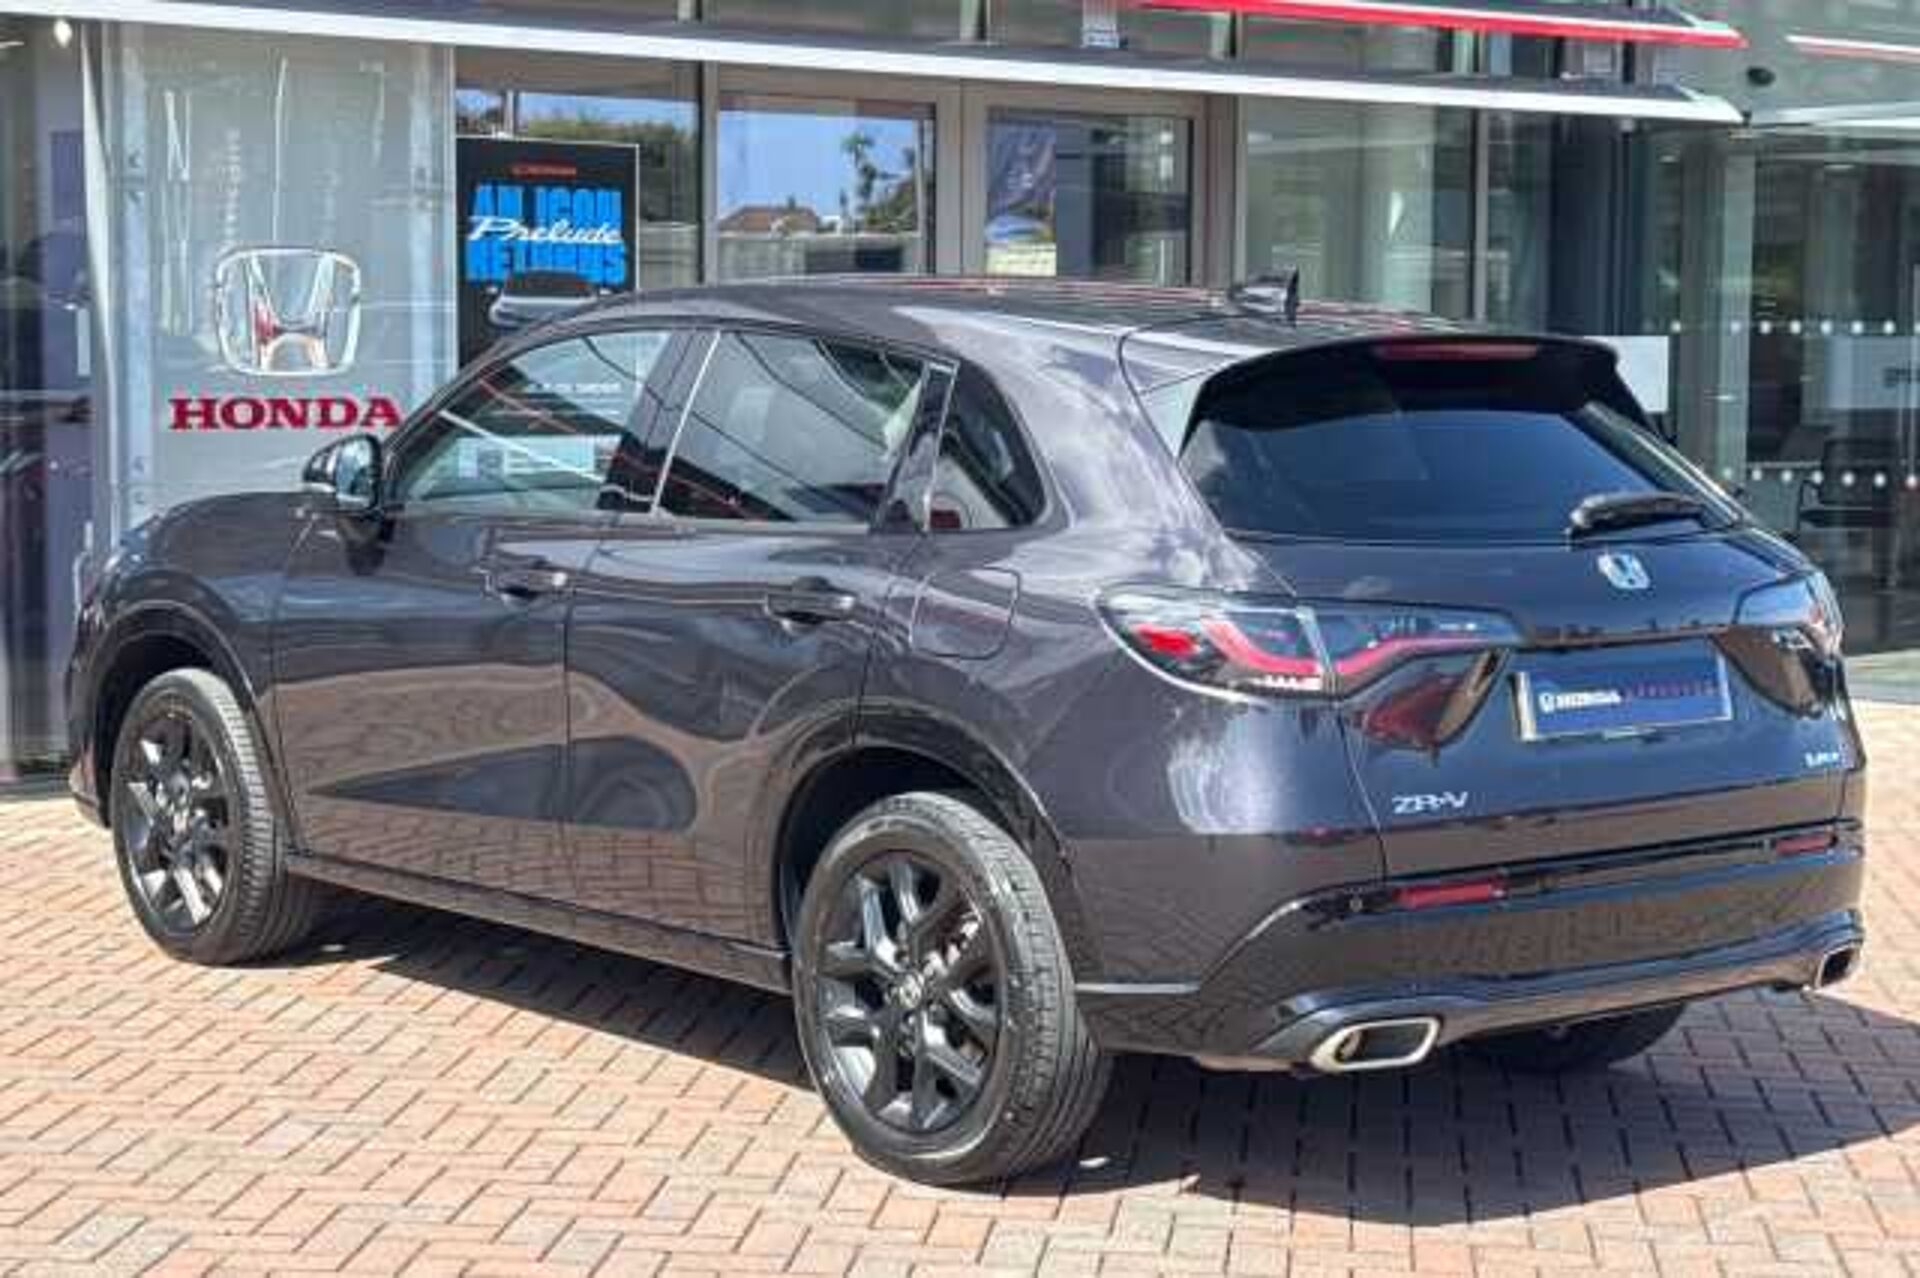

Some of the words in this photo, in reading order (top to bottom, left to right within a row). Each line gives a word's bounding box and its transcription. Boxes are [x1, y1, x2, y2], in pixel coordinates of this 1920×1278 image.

[468, 216, 622, 244] Prelude
[168, 398, 401, 430] HONDA
[1392, 791, 1468, 814] ZR-V
